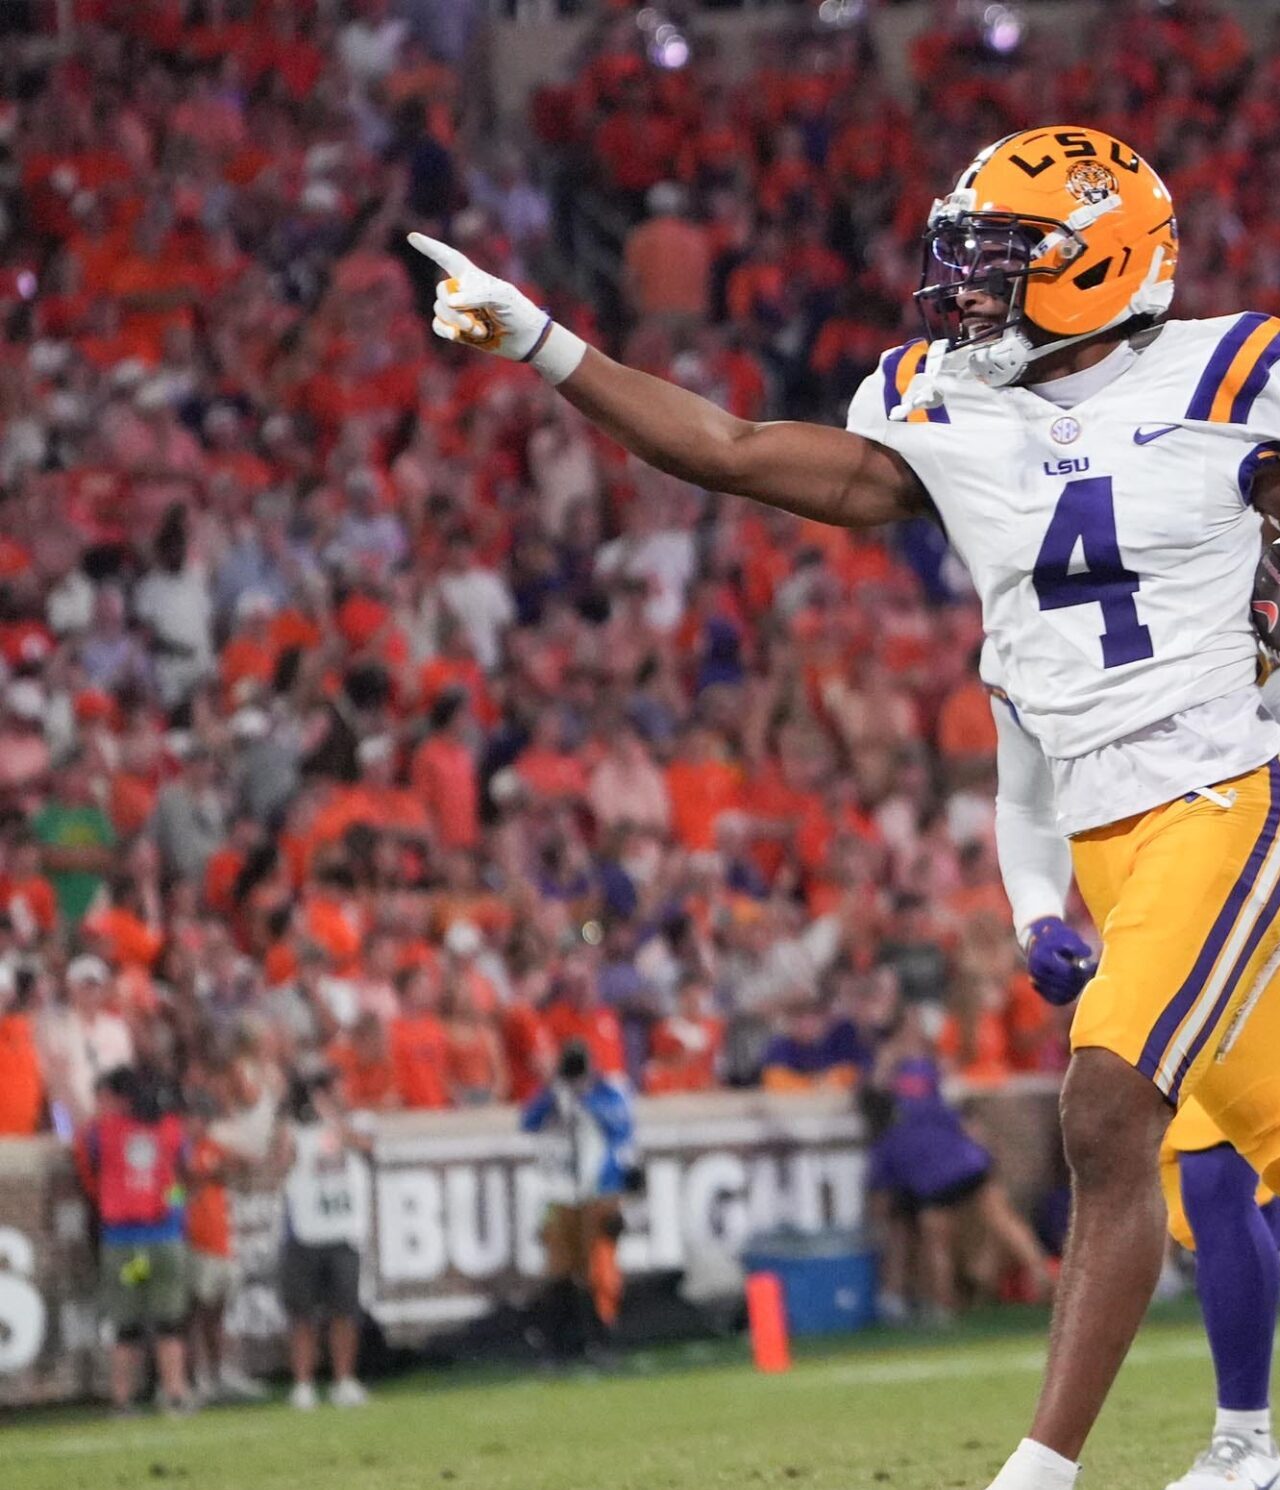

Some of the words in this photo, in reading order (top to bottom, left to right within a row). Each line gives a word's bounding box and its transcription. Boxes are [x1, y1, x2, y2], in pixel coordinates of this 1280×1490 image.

[1008, 132, 1140, 179] LSU
[1043, 456, 1089, 476] LSU
[1032, 475, 1154, 669] 4
